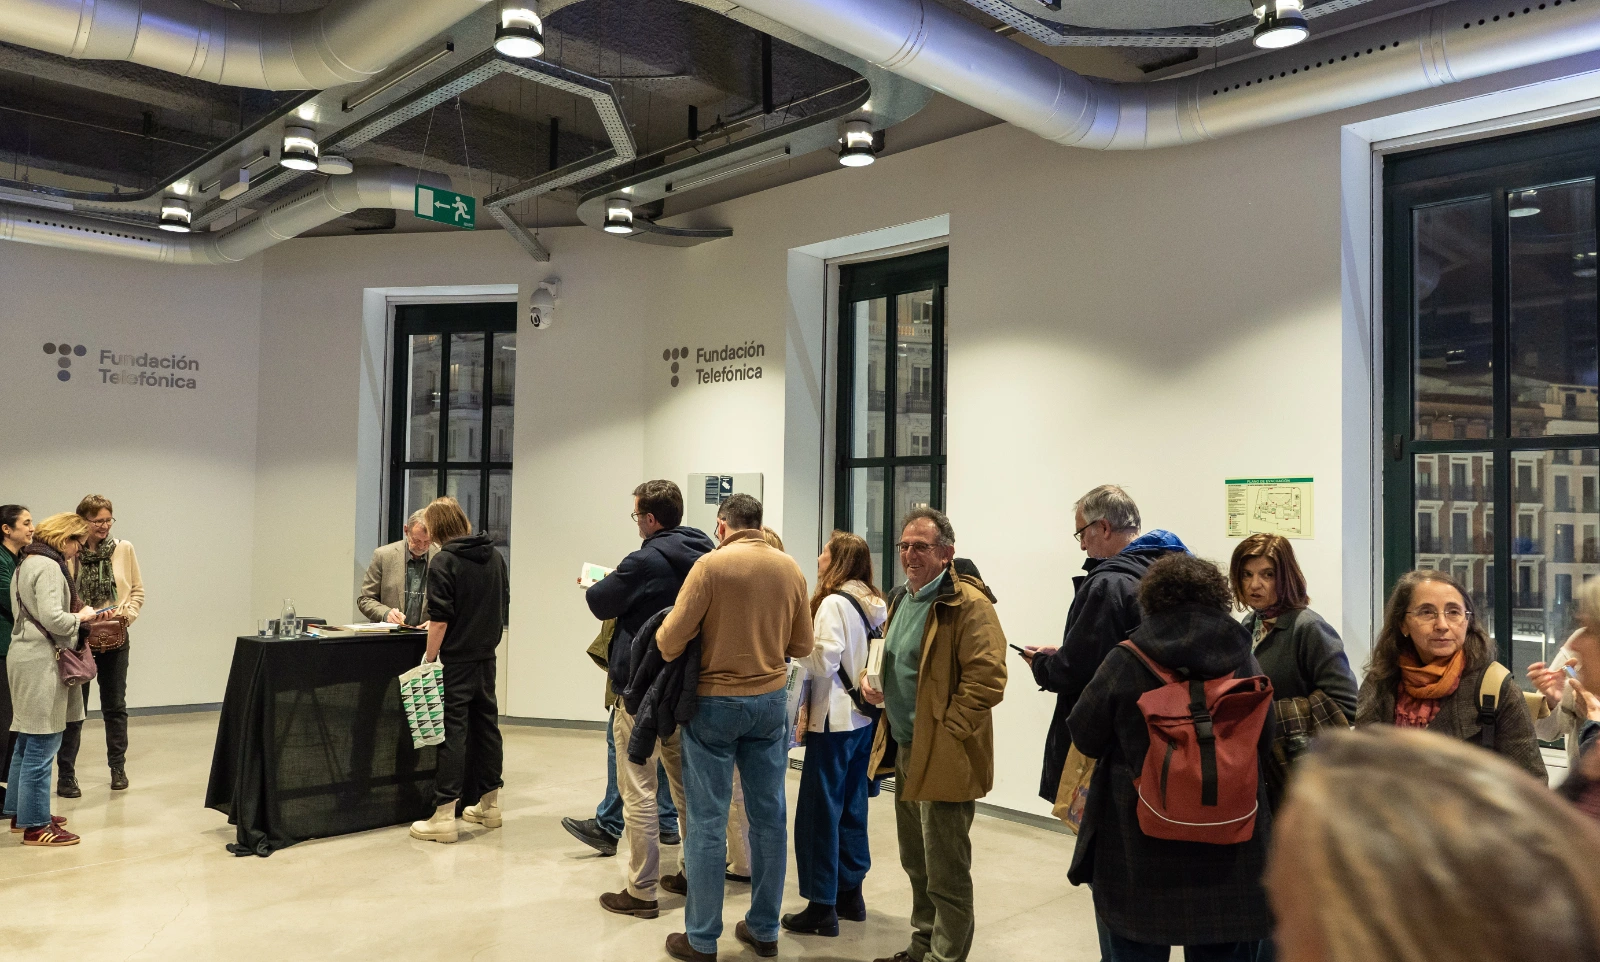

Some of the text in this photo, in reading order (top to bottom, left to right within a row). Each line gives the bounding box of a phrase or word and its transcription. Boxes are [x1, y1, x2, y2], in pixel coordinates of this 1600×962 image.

[99, 349, 200, 371] Fundación
[696, 340, 765, 364] Fundación
[98, 368, 197, 389] Telefónica
[695, 363, 763, 385] Telefónica
